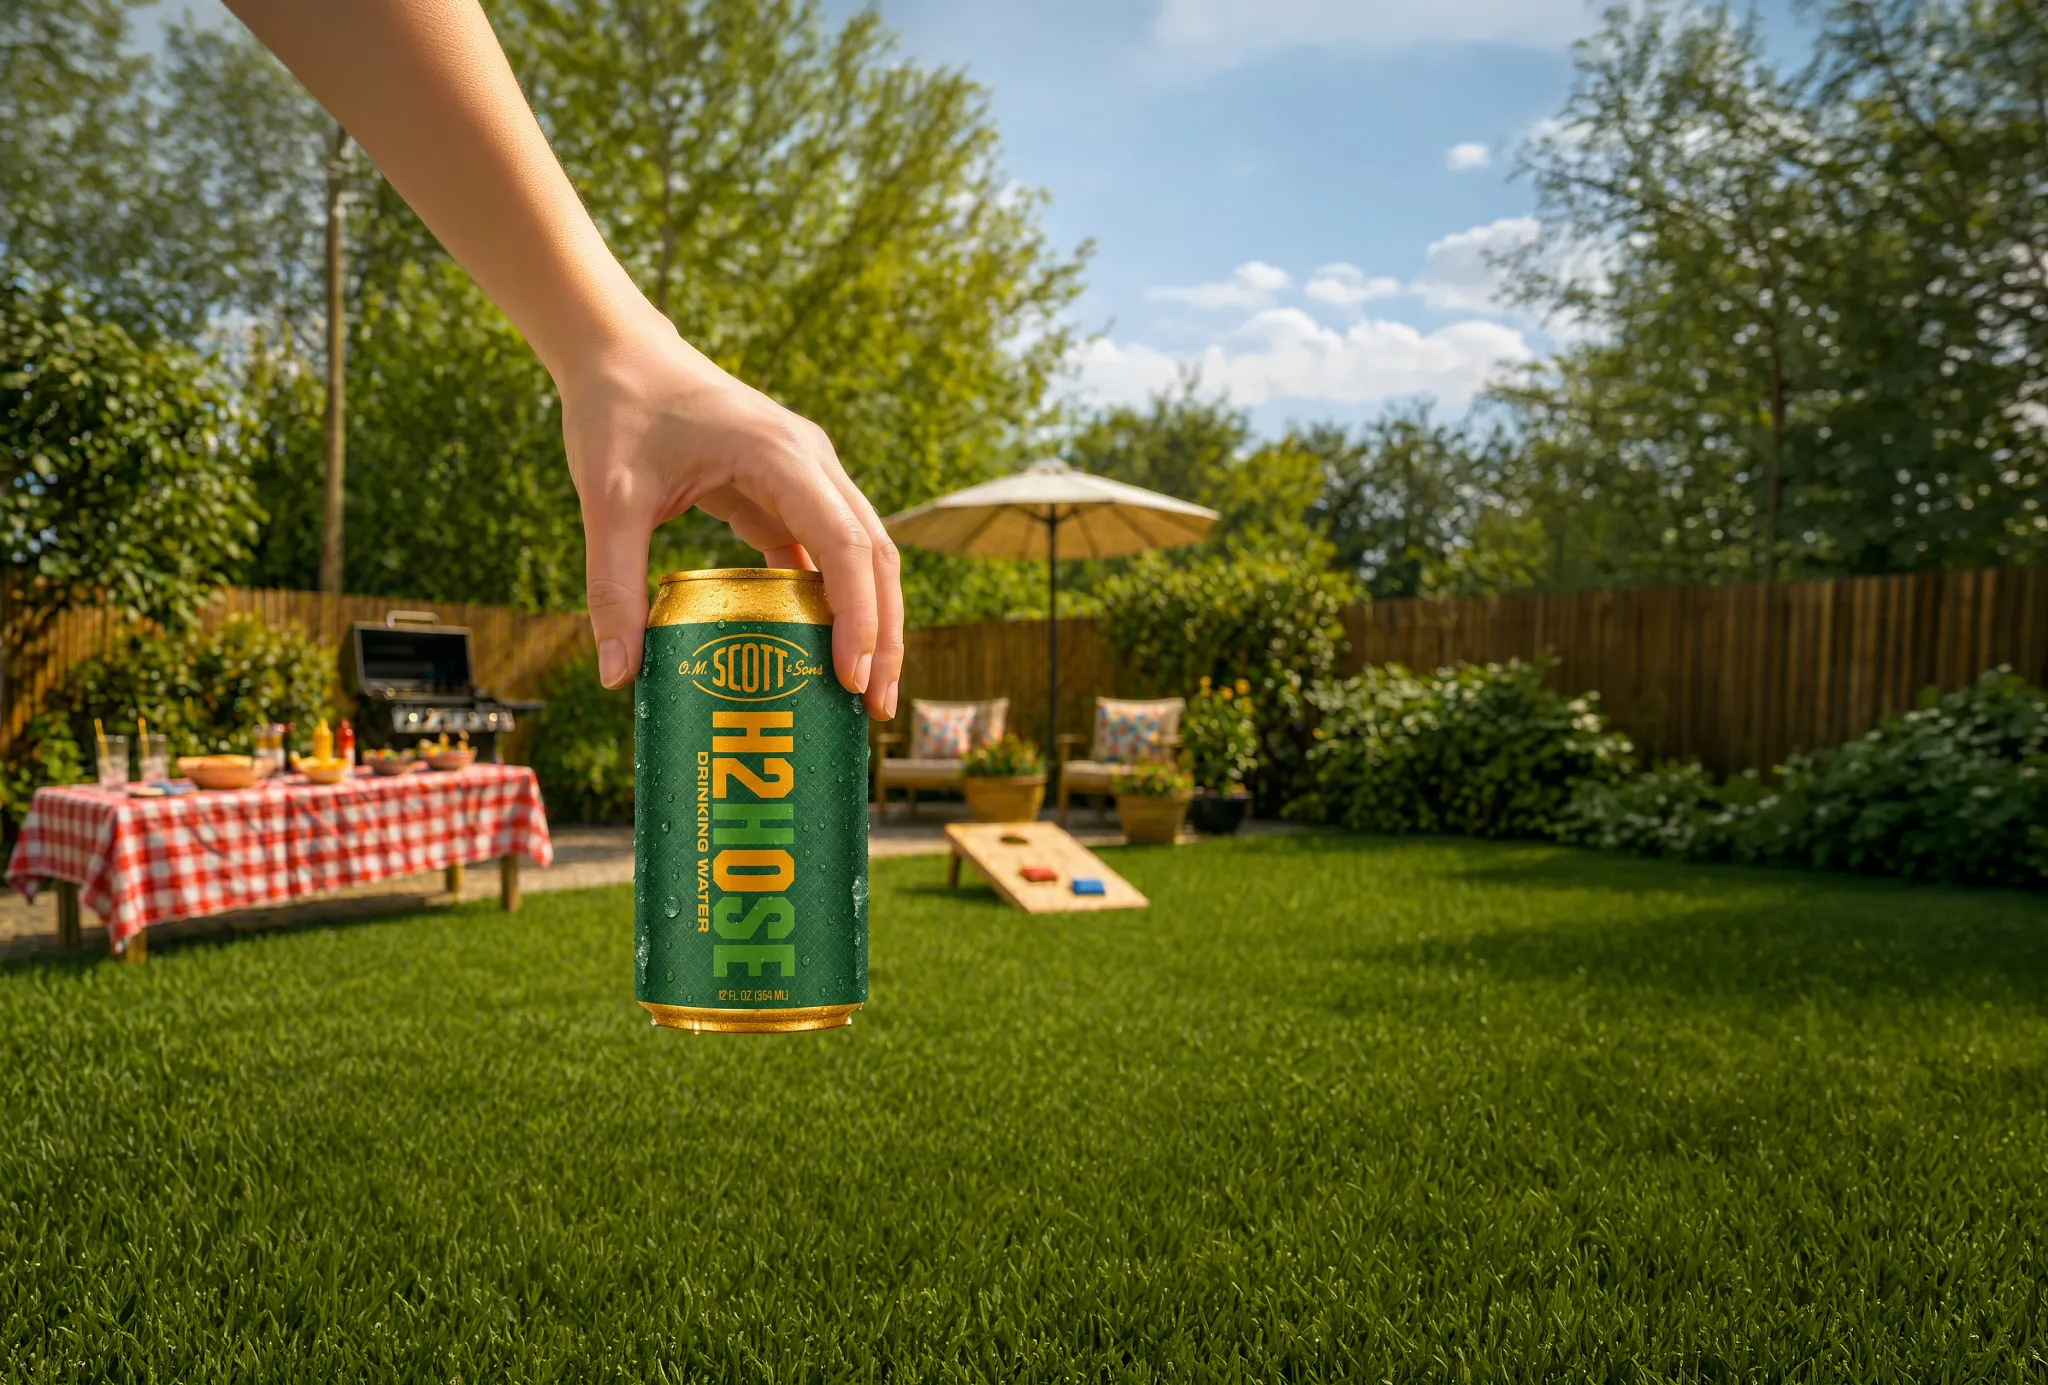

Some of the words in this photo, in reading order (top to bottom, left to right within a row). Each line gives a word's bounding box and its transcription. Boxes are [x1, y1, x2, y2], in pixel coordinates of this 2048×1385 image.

[678, 660, 708, 675] O.M.
[712, 642, 788, 693] SCOTT
[792, 660, 823, 676] Sons
[697, 751, 709, 853] DRINKING
[712, 710, 795, 978] H2HOSE
[697, 858, 710, 933] WATER
[728, 989, 738, 1001] FL
[740, 989, 752, 1001] OZ
